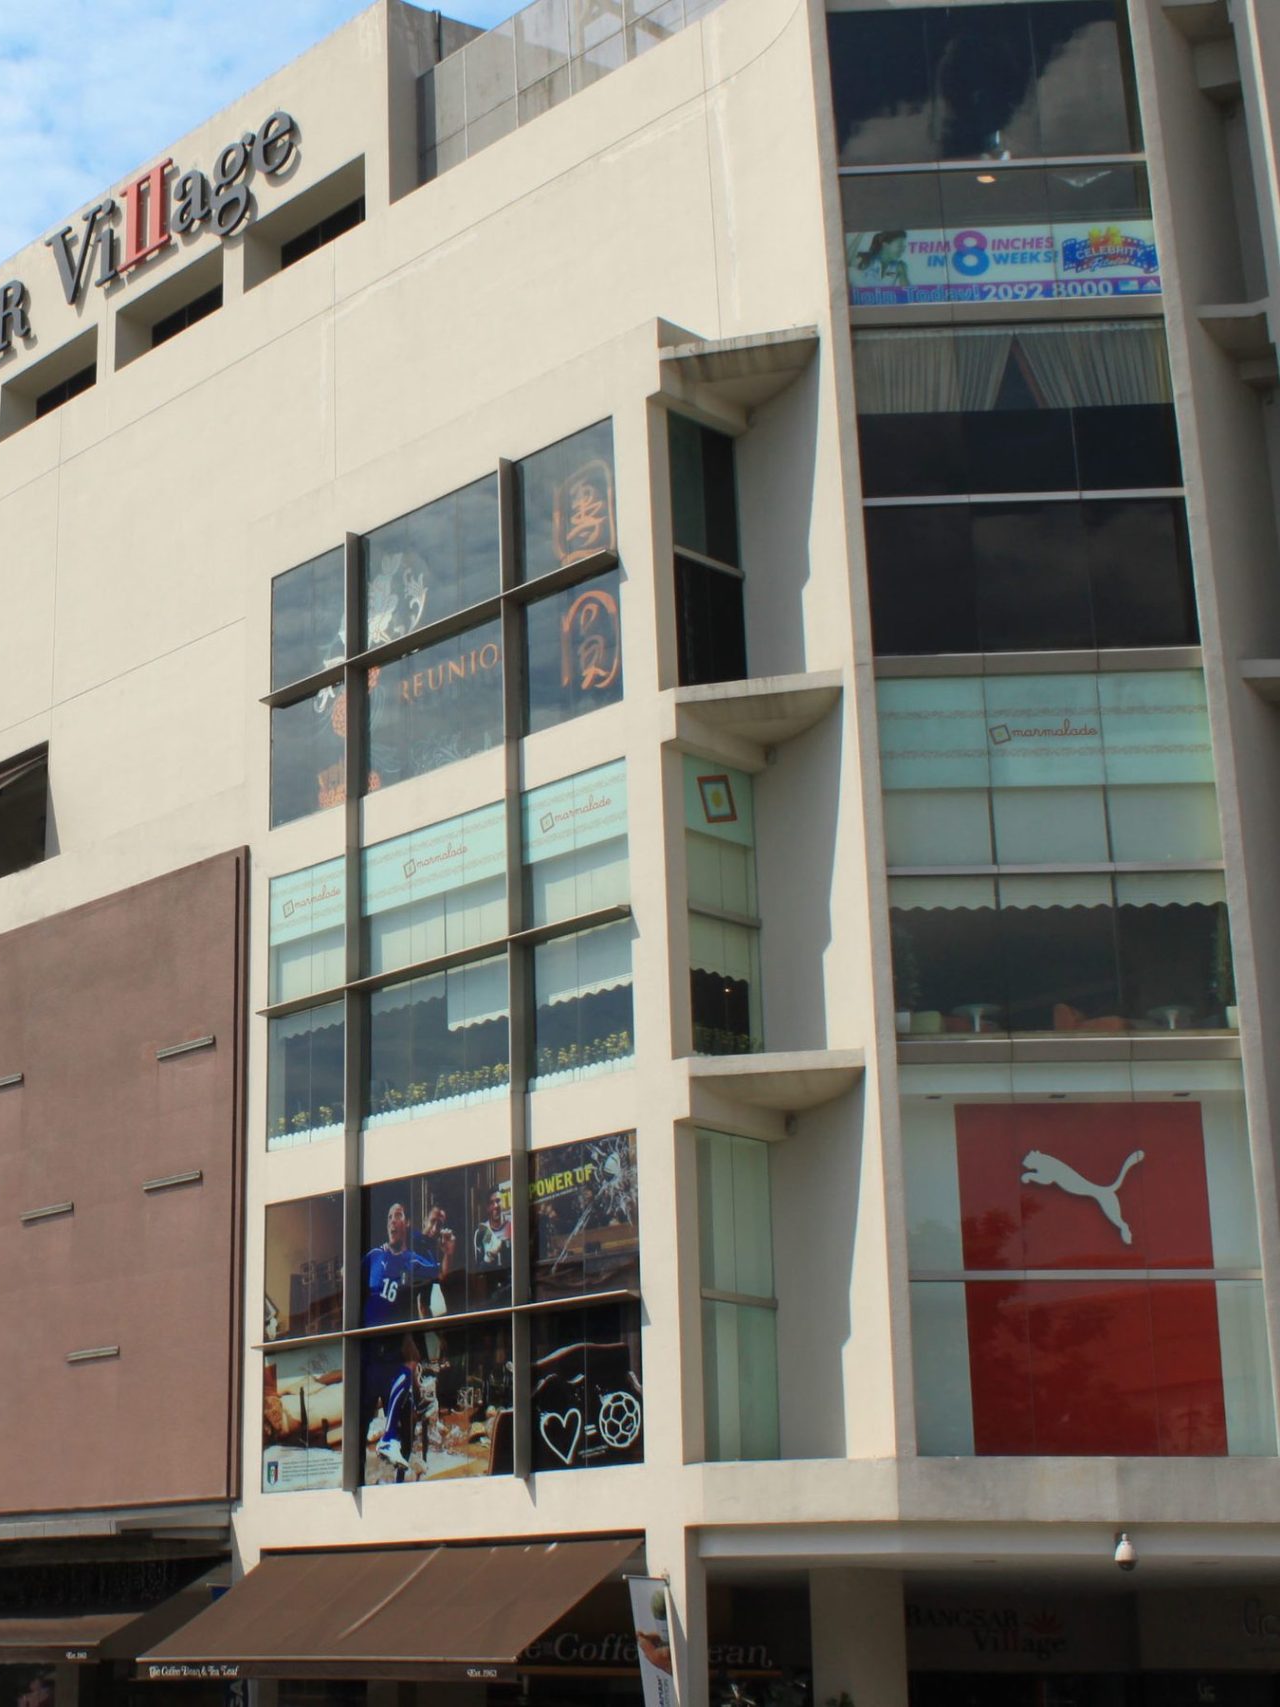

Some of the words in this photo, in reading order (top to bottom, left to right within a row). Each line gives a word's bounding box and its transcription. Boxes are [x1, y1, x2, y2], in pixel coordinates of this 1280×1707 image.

[45, 110, 295, 305] Village
[909, 239, 951, 255] TRIM
[952, 230, 990, 277] 8
[991, 236, 1053, 251] INCHES
[927, 255, 947, 268] IN
[993, 250, 1058, 266] WEEKS!
[1076, 246, 1144, 260] CELEBRITY
[983, 284, 1043, 302] 2092
[1051, 280, 1113, 298] 8000
[397, 643, 499, 704] REUNIO
[1010, 719, 1098, 738] marmalade
[555, 794, 612, 822] marmalade
[416, 841, 468, 868] marmalade
[529, 1170, 573, 1199] POWER
[575, 1163, 594, 1184] OF
[380, 1277, 398, 1302] 16
[908, 1605, 1018, 1629] BANGSAR
[971, 1629, 1067, 1660] Village
